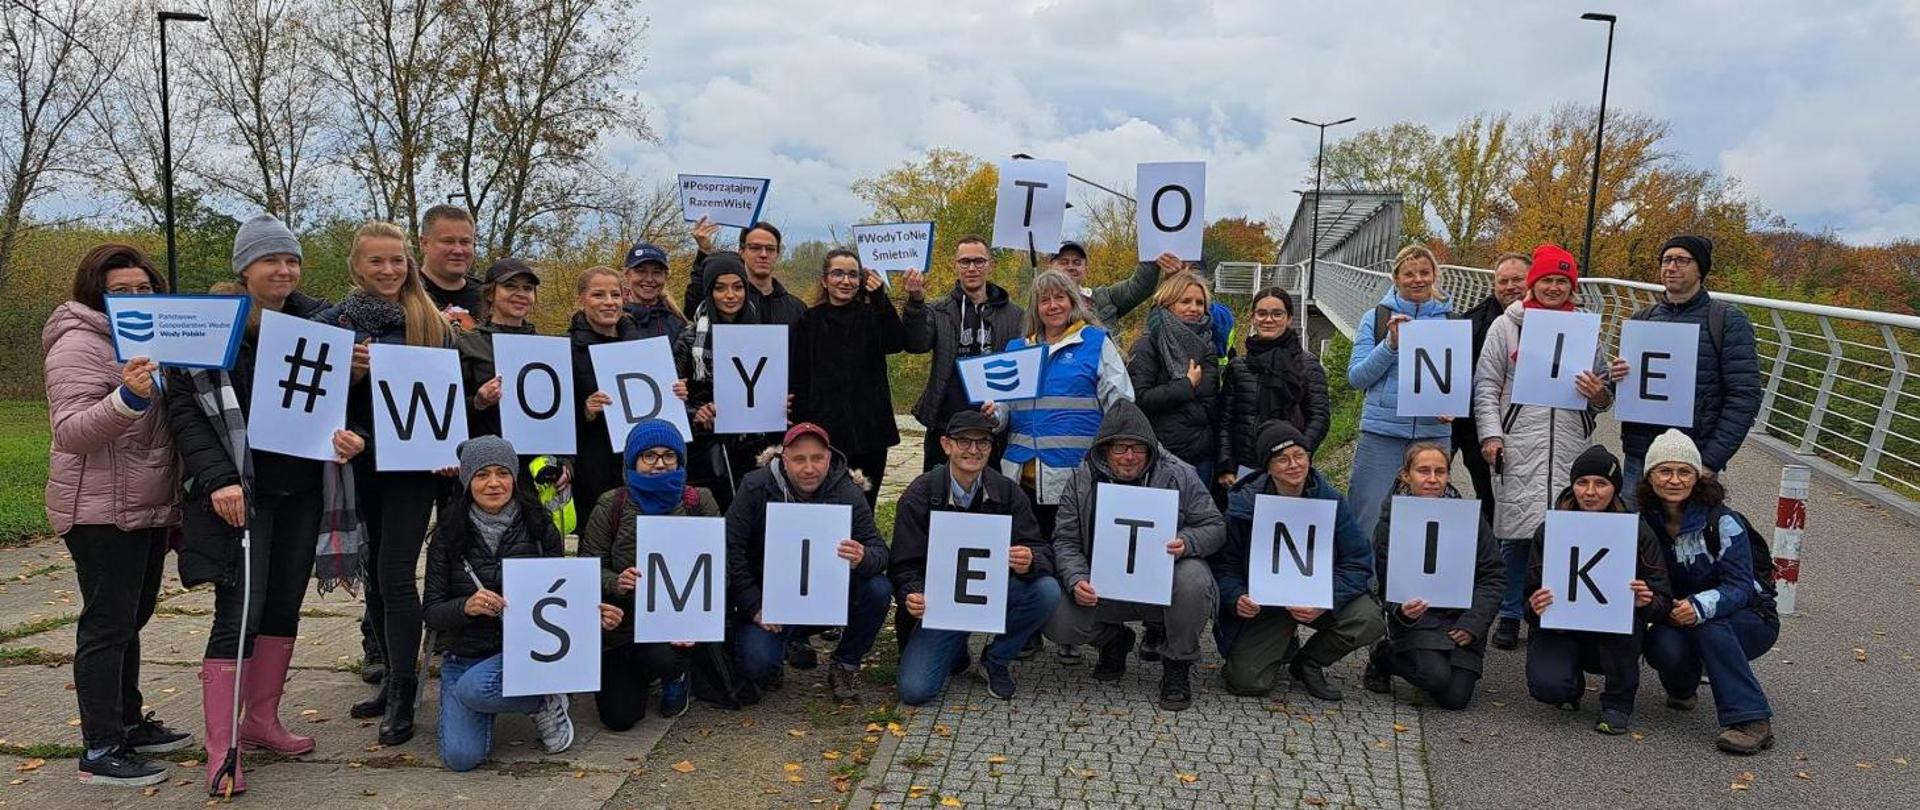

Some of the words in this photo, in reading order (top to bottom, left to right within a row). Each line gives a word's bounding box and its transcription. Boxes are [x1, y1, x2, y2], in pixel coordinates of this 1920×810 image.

[683, 181, 759, 195] #Posprzątajmy
[1014, 179, 1049, 228] T
[1150, 183, 1193, 233] O
[857, 230, 927, 244] #WodyToNie
[872, 246, 919, 261] Śmietnik
[278, 336, 334, 414] #
[731, 356, 769, 409] Y
[1413, 347, 1453, 395] N
[1550, 332, 1565, 379] I
[1638, 351, 1672, 403] E
[377, 379, 458, 442] W
[516, 361, 562, 421] O
[616, 372, 663, 424] D
[799, 538, 811, 597] I
[1113, 517, 1155, 575] T
[1271, 521, 1317, 578] N
[1422, 520, 1440, 575] I
[646, 552, 713, 613] M
[953, 547, 992, 606] E
[1567, 545, 1611, 606] K
[529, 578, 571, 664] Ś
